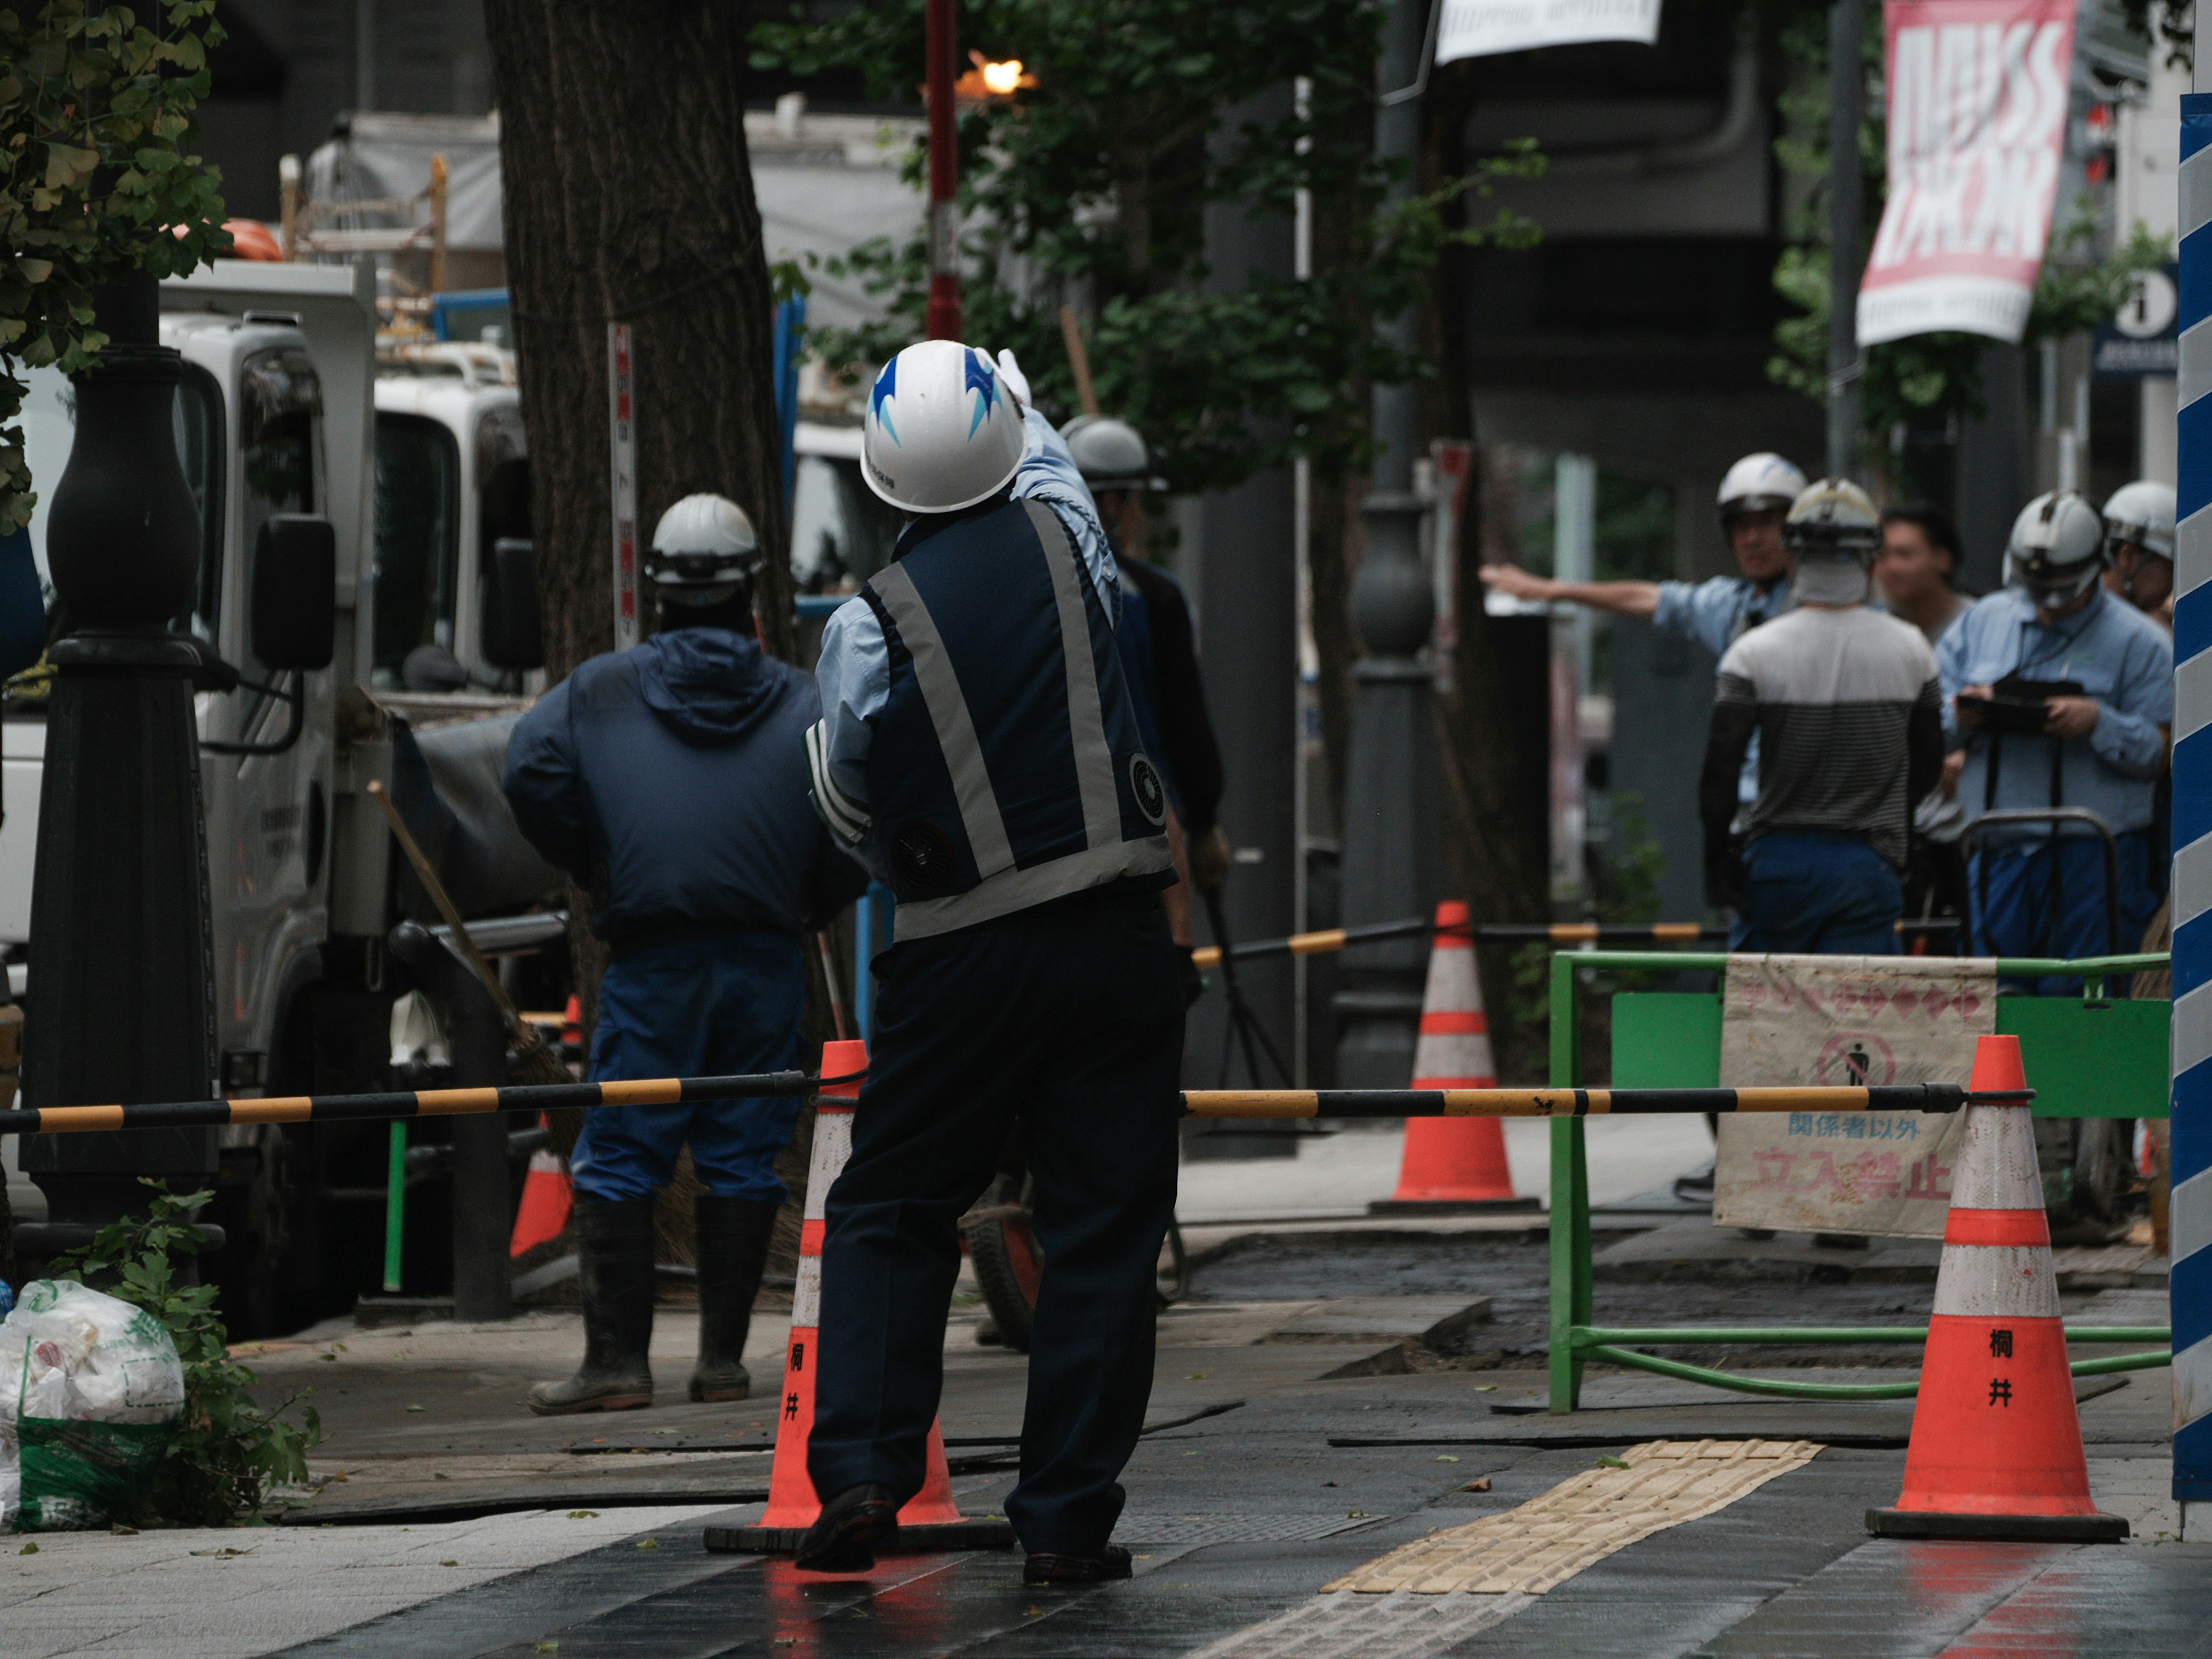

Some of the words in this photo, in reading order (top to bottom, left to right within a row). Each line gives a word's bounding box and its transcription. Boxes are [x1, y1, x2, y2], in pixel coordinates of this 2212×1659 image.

[1787, 1112, 1921, 1141] 関係者以外
[1749, 1146, 1952, 1201] 立入禁止
[1989, 1328, 2013, 1407] 桐井
